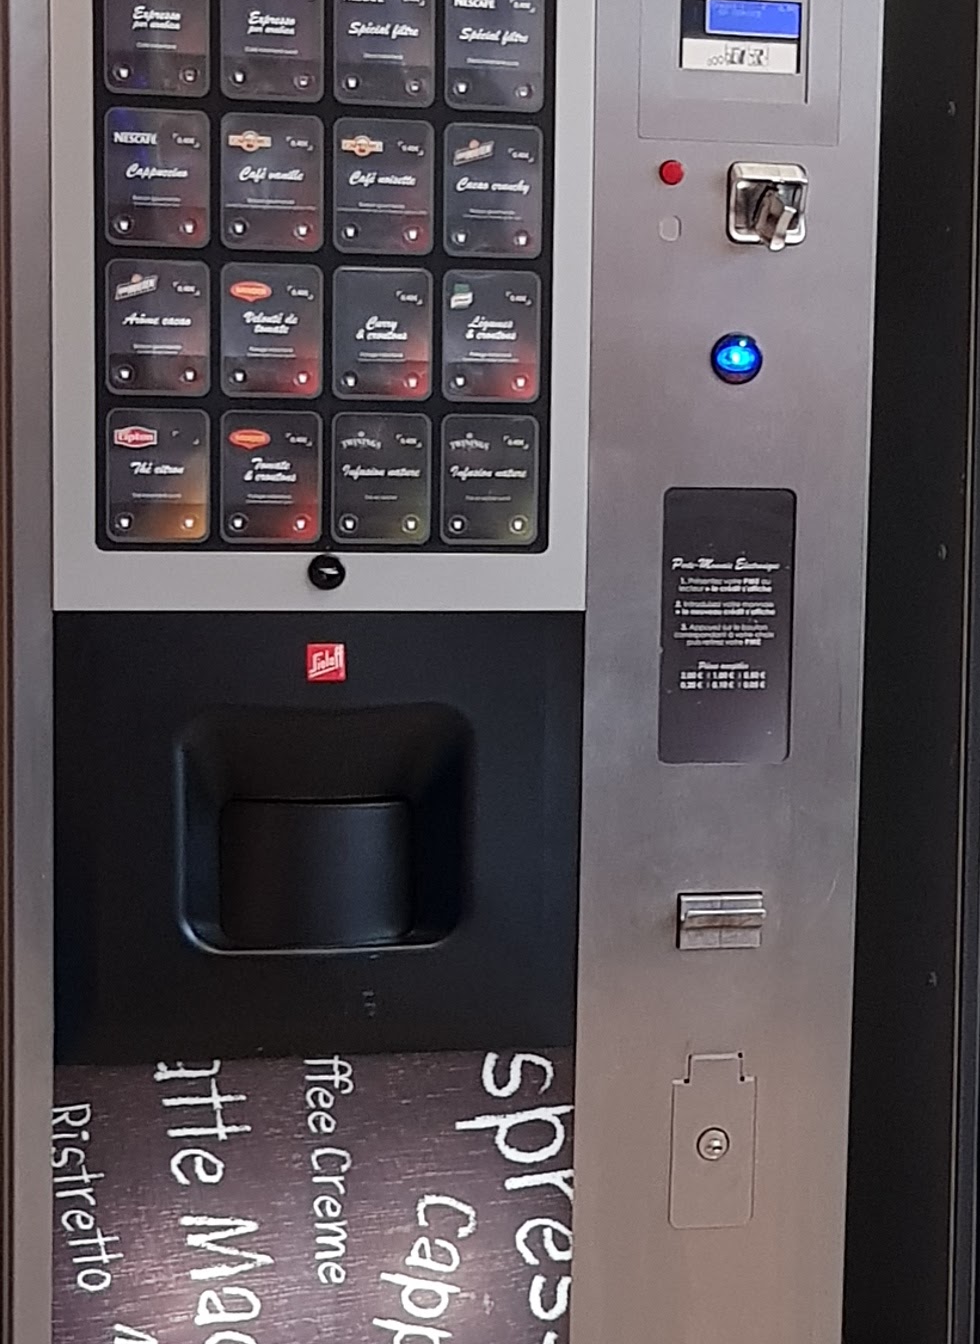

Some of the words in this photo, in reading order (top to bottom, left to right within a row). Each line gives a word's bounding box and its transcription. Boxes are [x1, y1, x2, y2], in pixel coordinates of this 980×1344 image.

[239, 166, 267, 183] Café
[349, 170, 377, 187] Café
[377, 173, 417, 187] noisette
[456, 177, 489, 192] Cacao
[243, 310, 282, 325] Velouté
[285, 313, 299, 324] de
[467, 315, 514, 331] Légumes
[356, 329, 364, 340] &
[465, 328, 474, 340] &
[117, 431, 155, 444] Lipton
[341, 438, 382, 451] TWININGS
[449, 439, 490, 451] TWININGS
[130, 462, 152, 475] Thé
[154, 463, 184, 475] citron
[251, 458, 291, 471] Tomate
[342, 465, 385, 480] Infusion
[450, 465, 492, 481] Infusion
[51, 1103, 124, 1294] Ristretto
[308, 1150, 353, 1287] Creme
